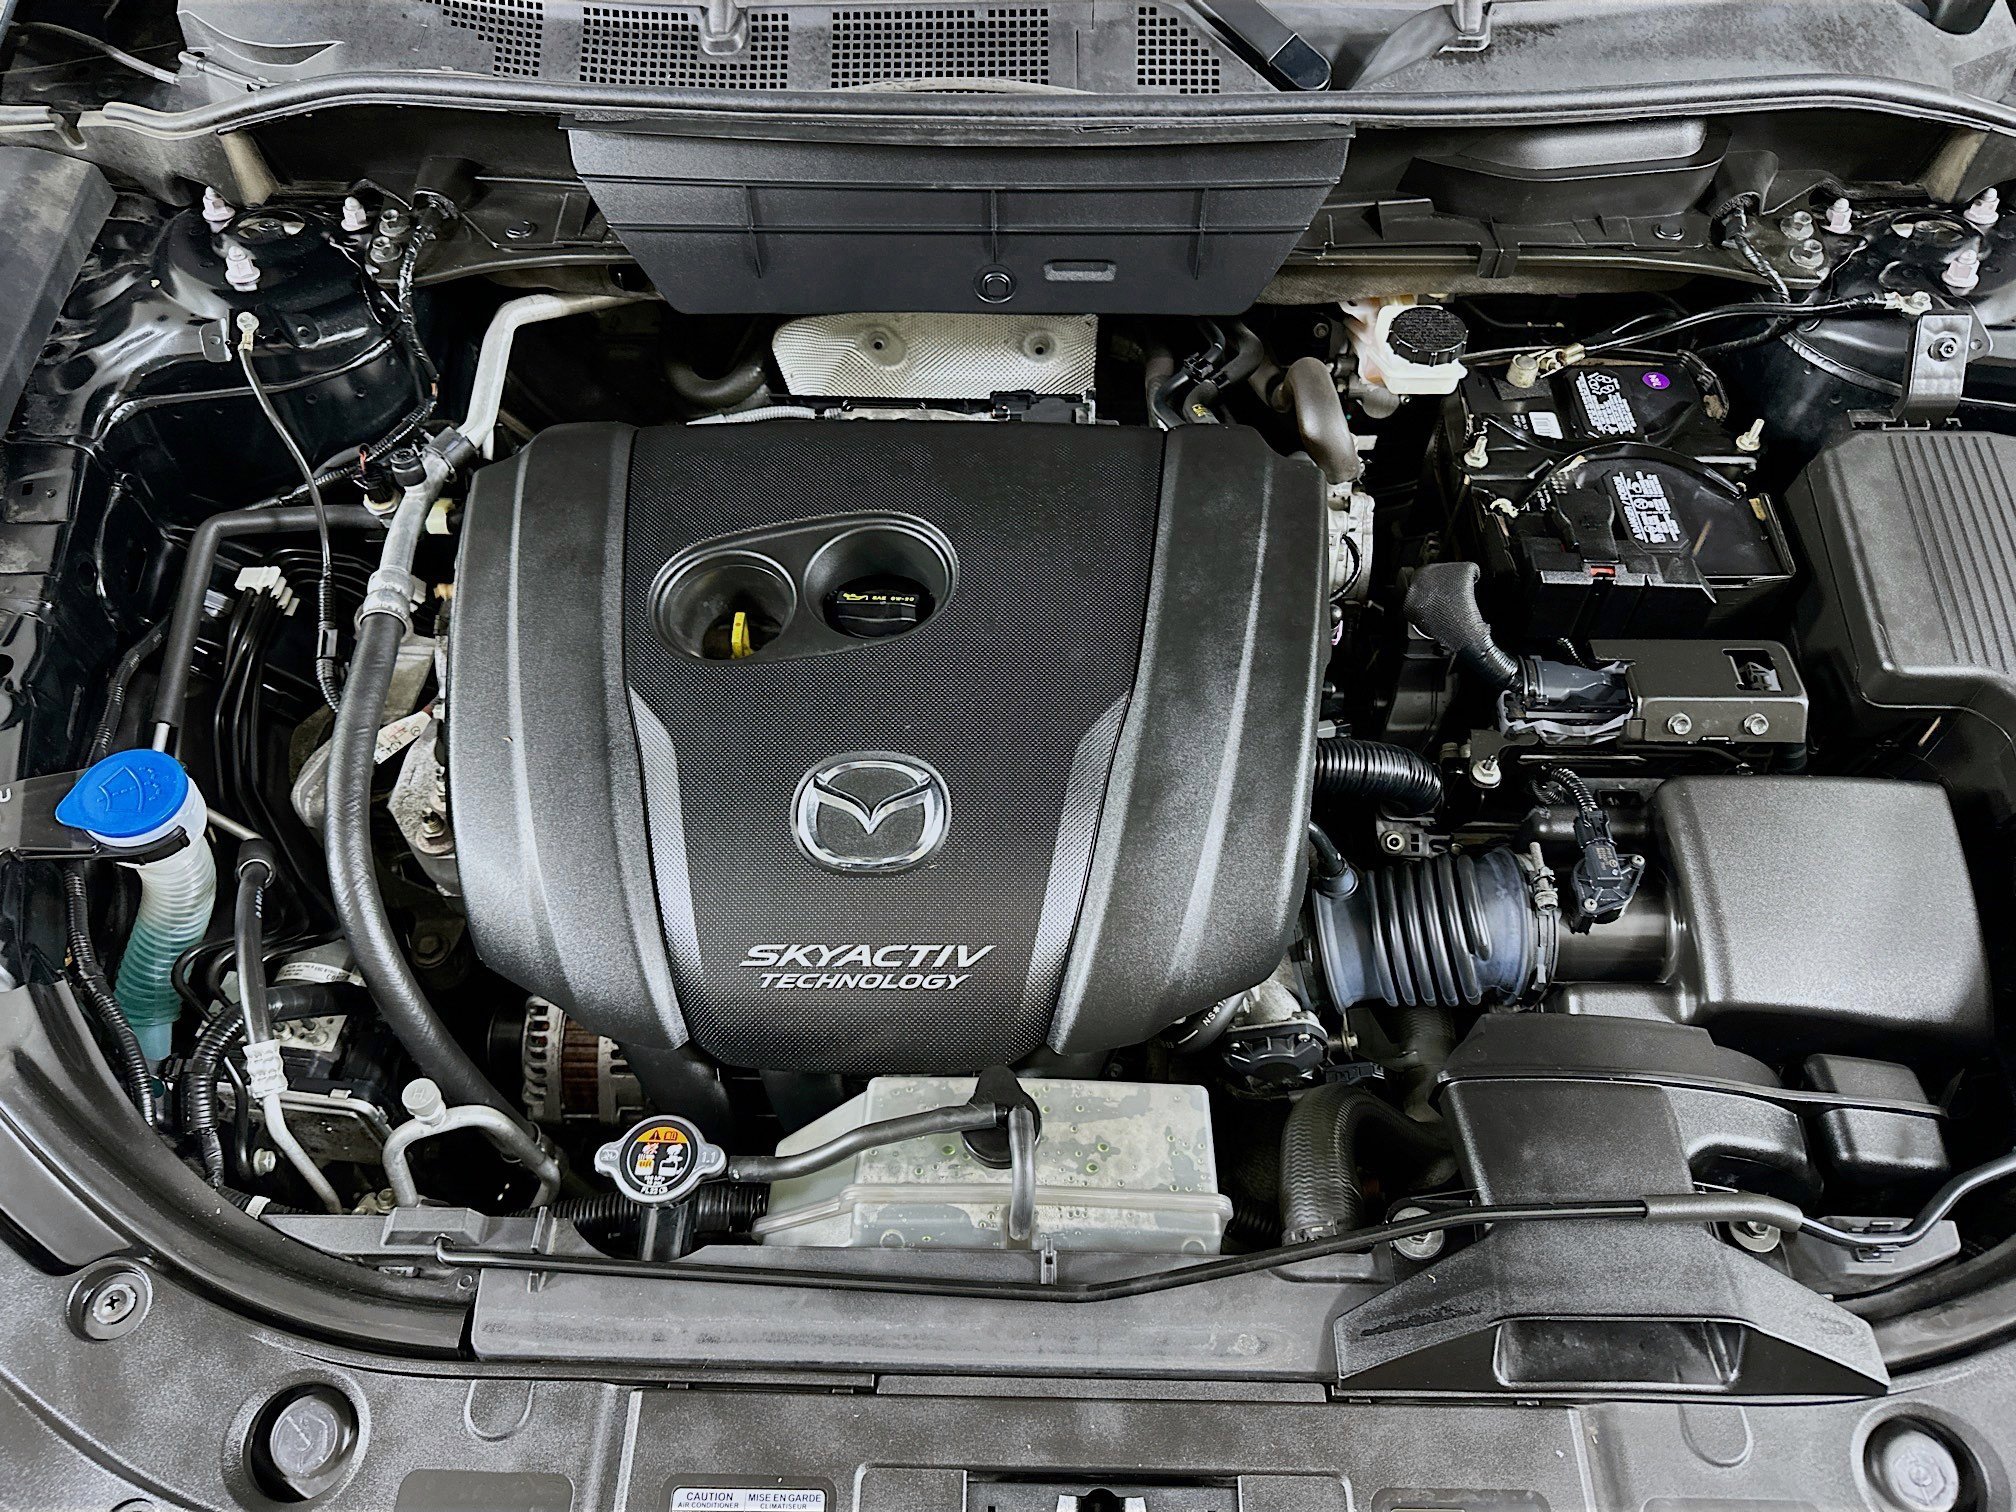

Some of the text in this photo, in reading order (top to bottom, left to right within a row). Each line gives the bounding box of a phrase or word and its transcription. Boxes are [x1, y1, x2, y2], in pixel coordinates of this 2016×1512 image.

[739, 944, 997, 968] SKYACTIV
[758, 972, 973, 991] TECHNOLOGY
[686, 1492, 734, 1501] CAUTION
[748, 1493, 821, 1503] MISE EN GARDE
